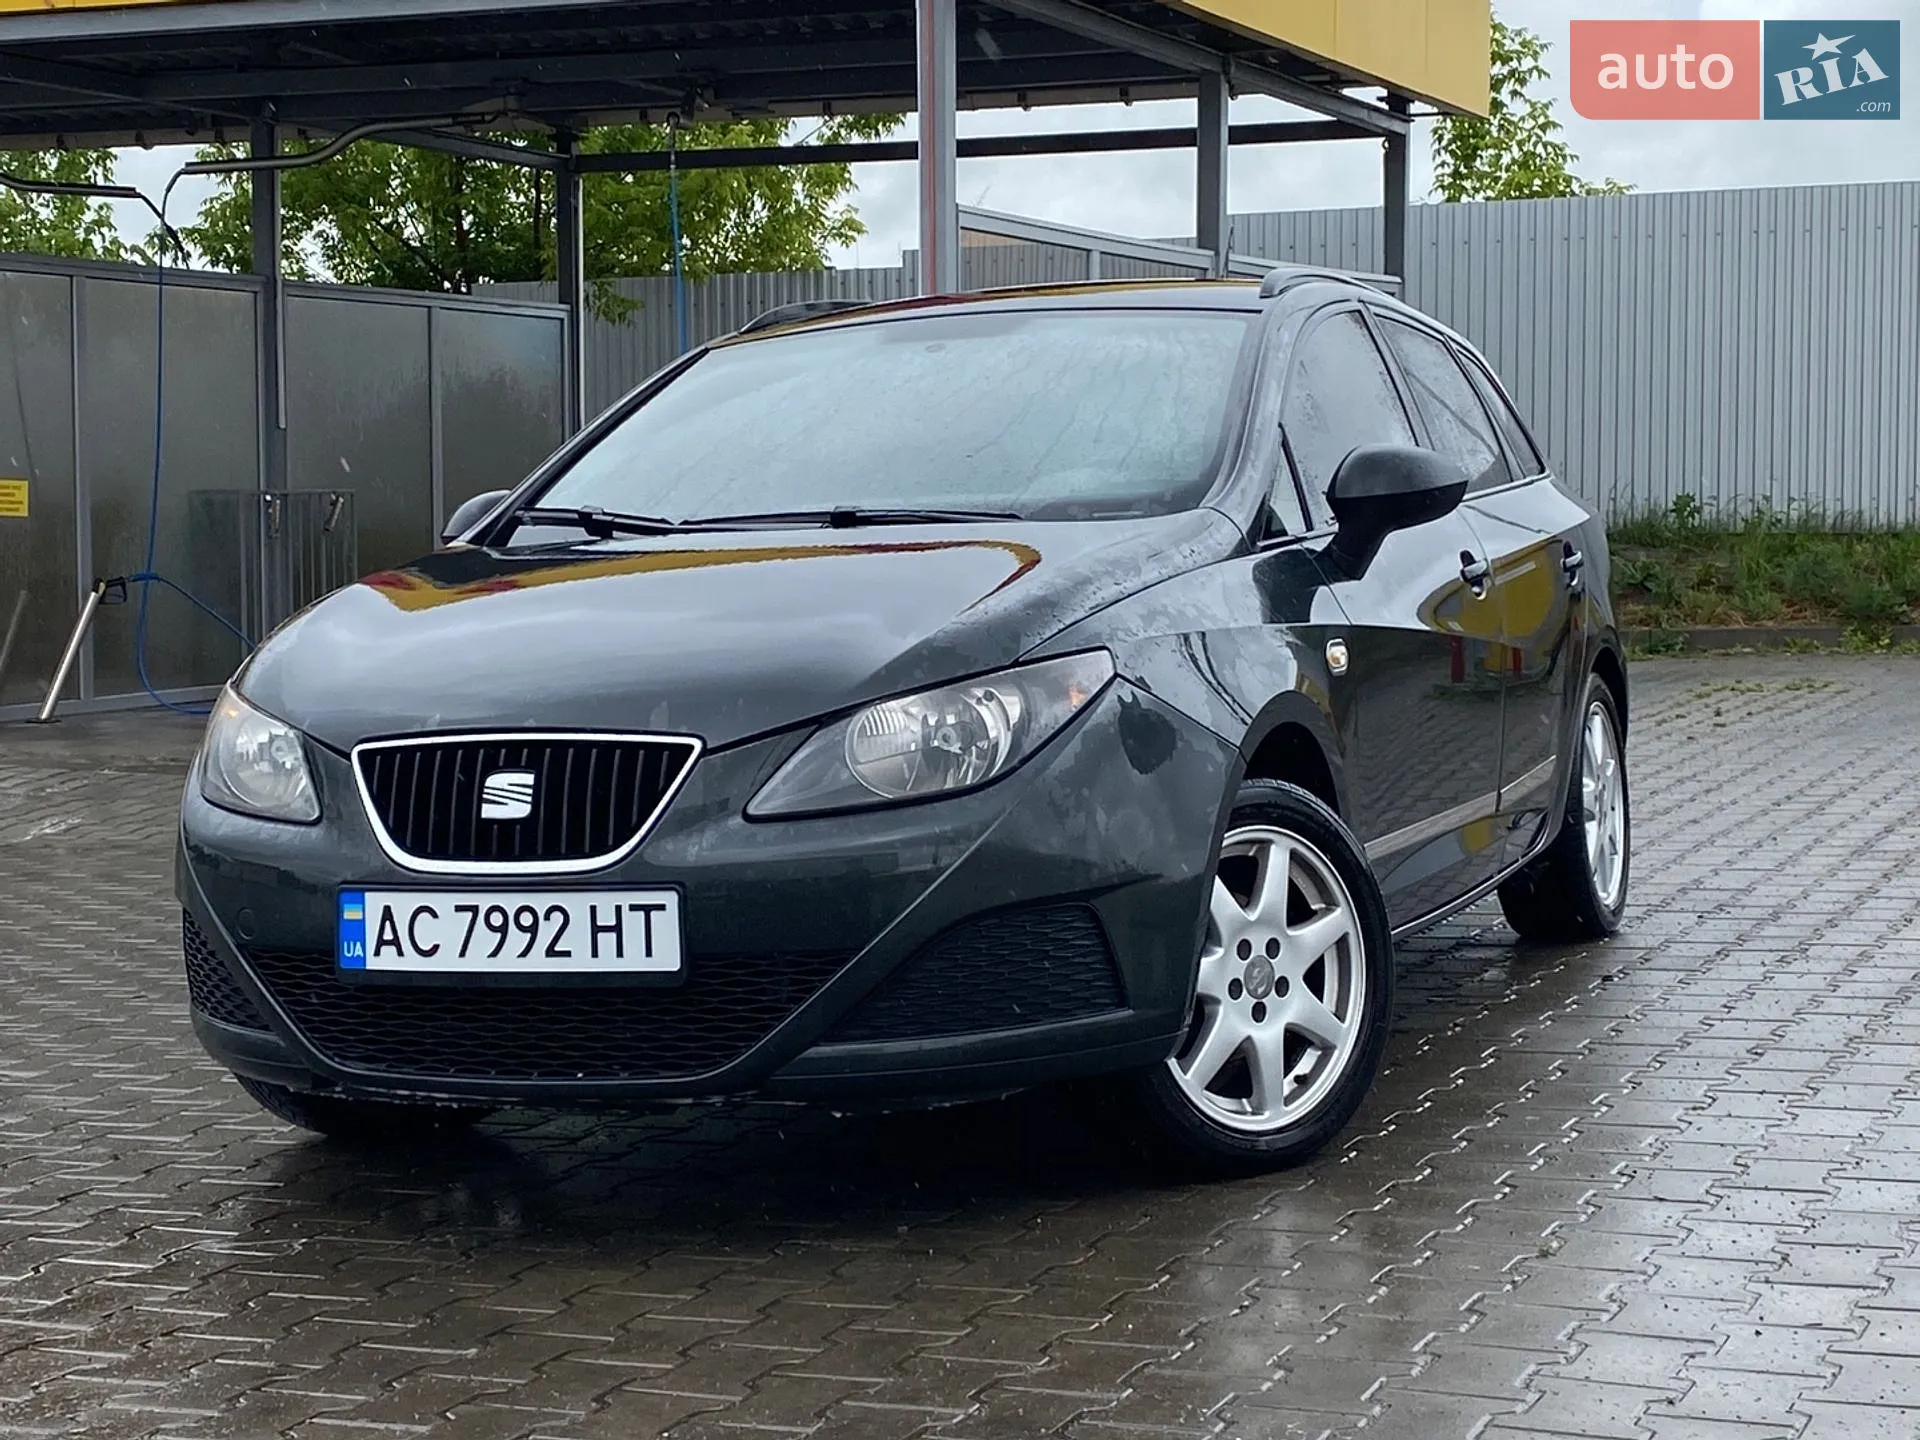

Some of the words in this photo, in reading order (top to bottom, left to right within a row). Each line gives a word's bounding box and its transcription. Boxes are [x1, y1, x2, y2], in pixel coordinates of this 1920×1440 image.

[373, 904, 441, 958] AC
[454, 904, 572, 959] 7992
[589, 903, 667, 959] HT
[343, 941, 364, 958] UA
